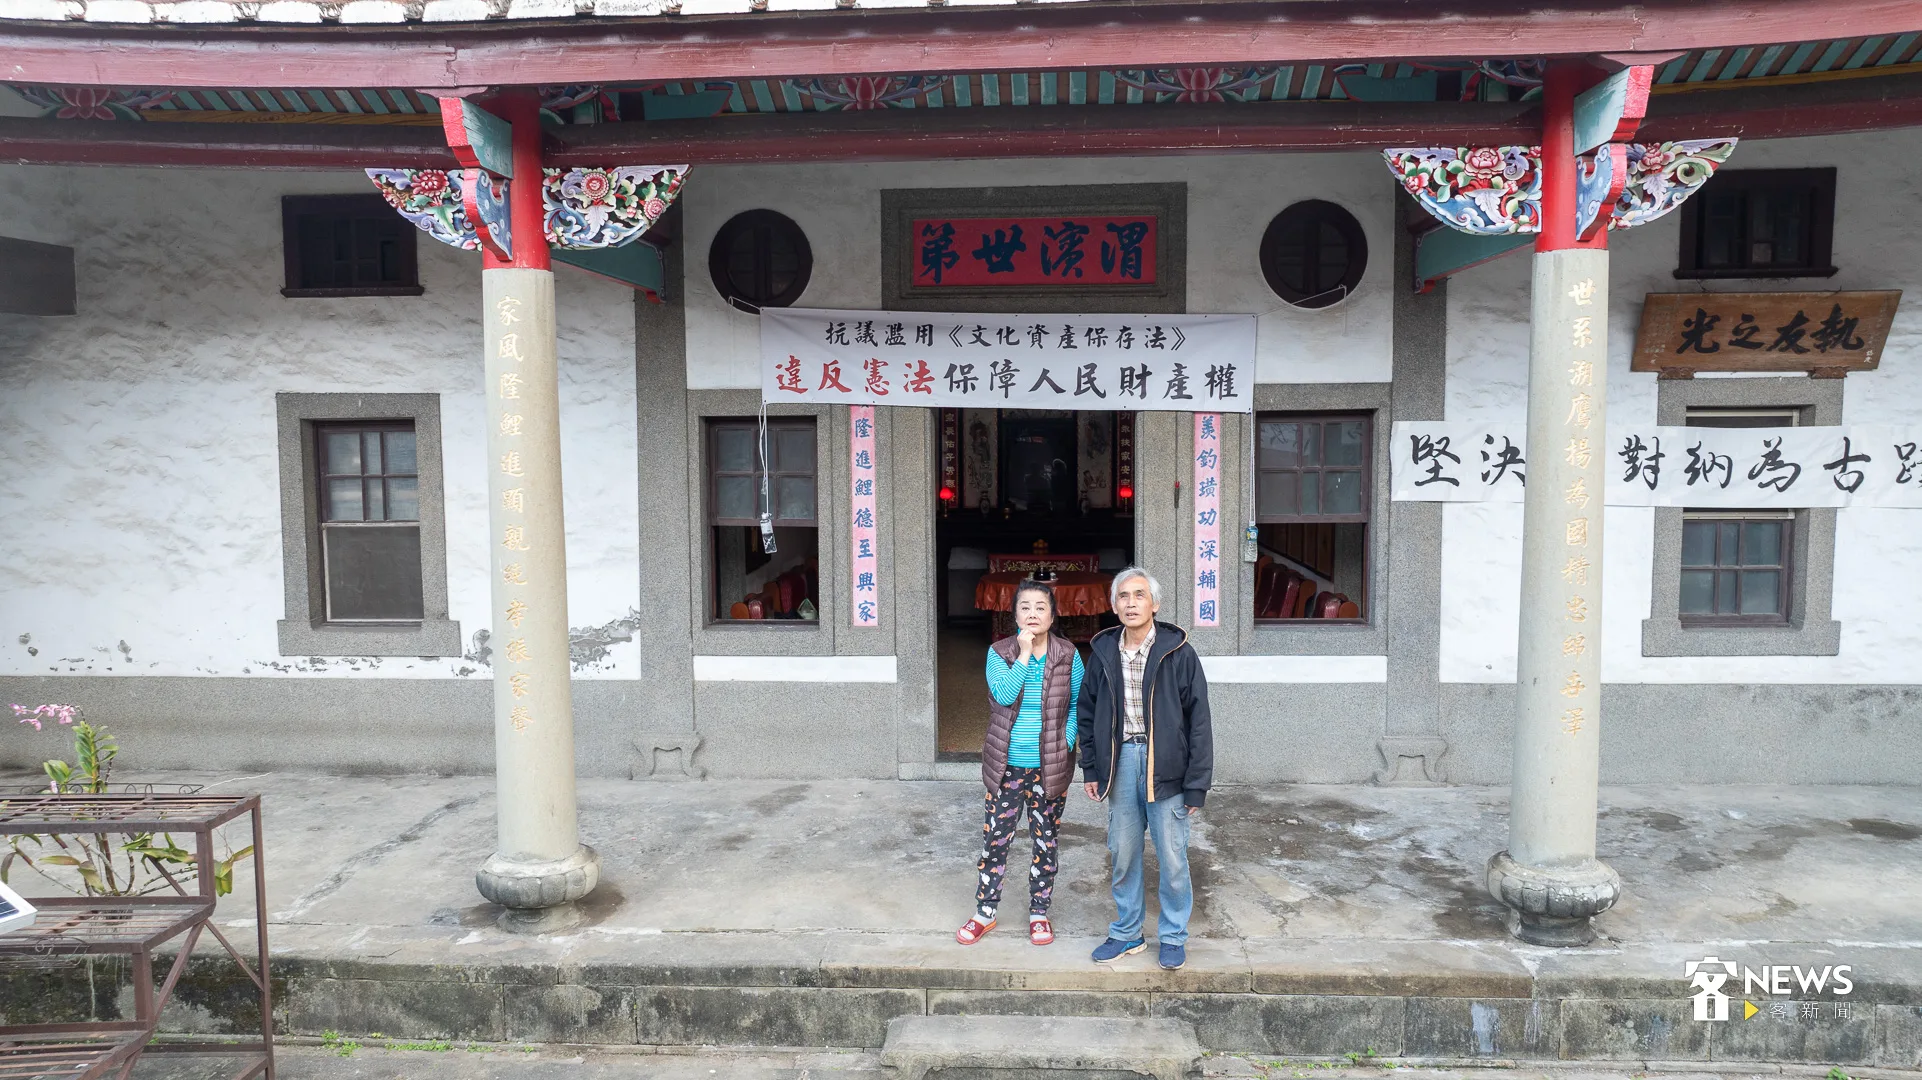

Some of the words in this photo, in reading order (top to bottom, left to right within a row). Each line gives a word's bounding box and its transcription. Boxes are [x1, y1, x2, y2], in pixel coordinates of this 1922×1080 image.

[919, 221, 1149, 284] 渭濱世第
[825, 320, 1186, 351] 抗議濫用《文化資產保存法》
[775, 354, 1239, 400] 違反憲法保障人民財產權
[854, 405, 876, 622] 隆進鯉德至興家
